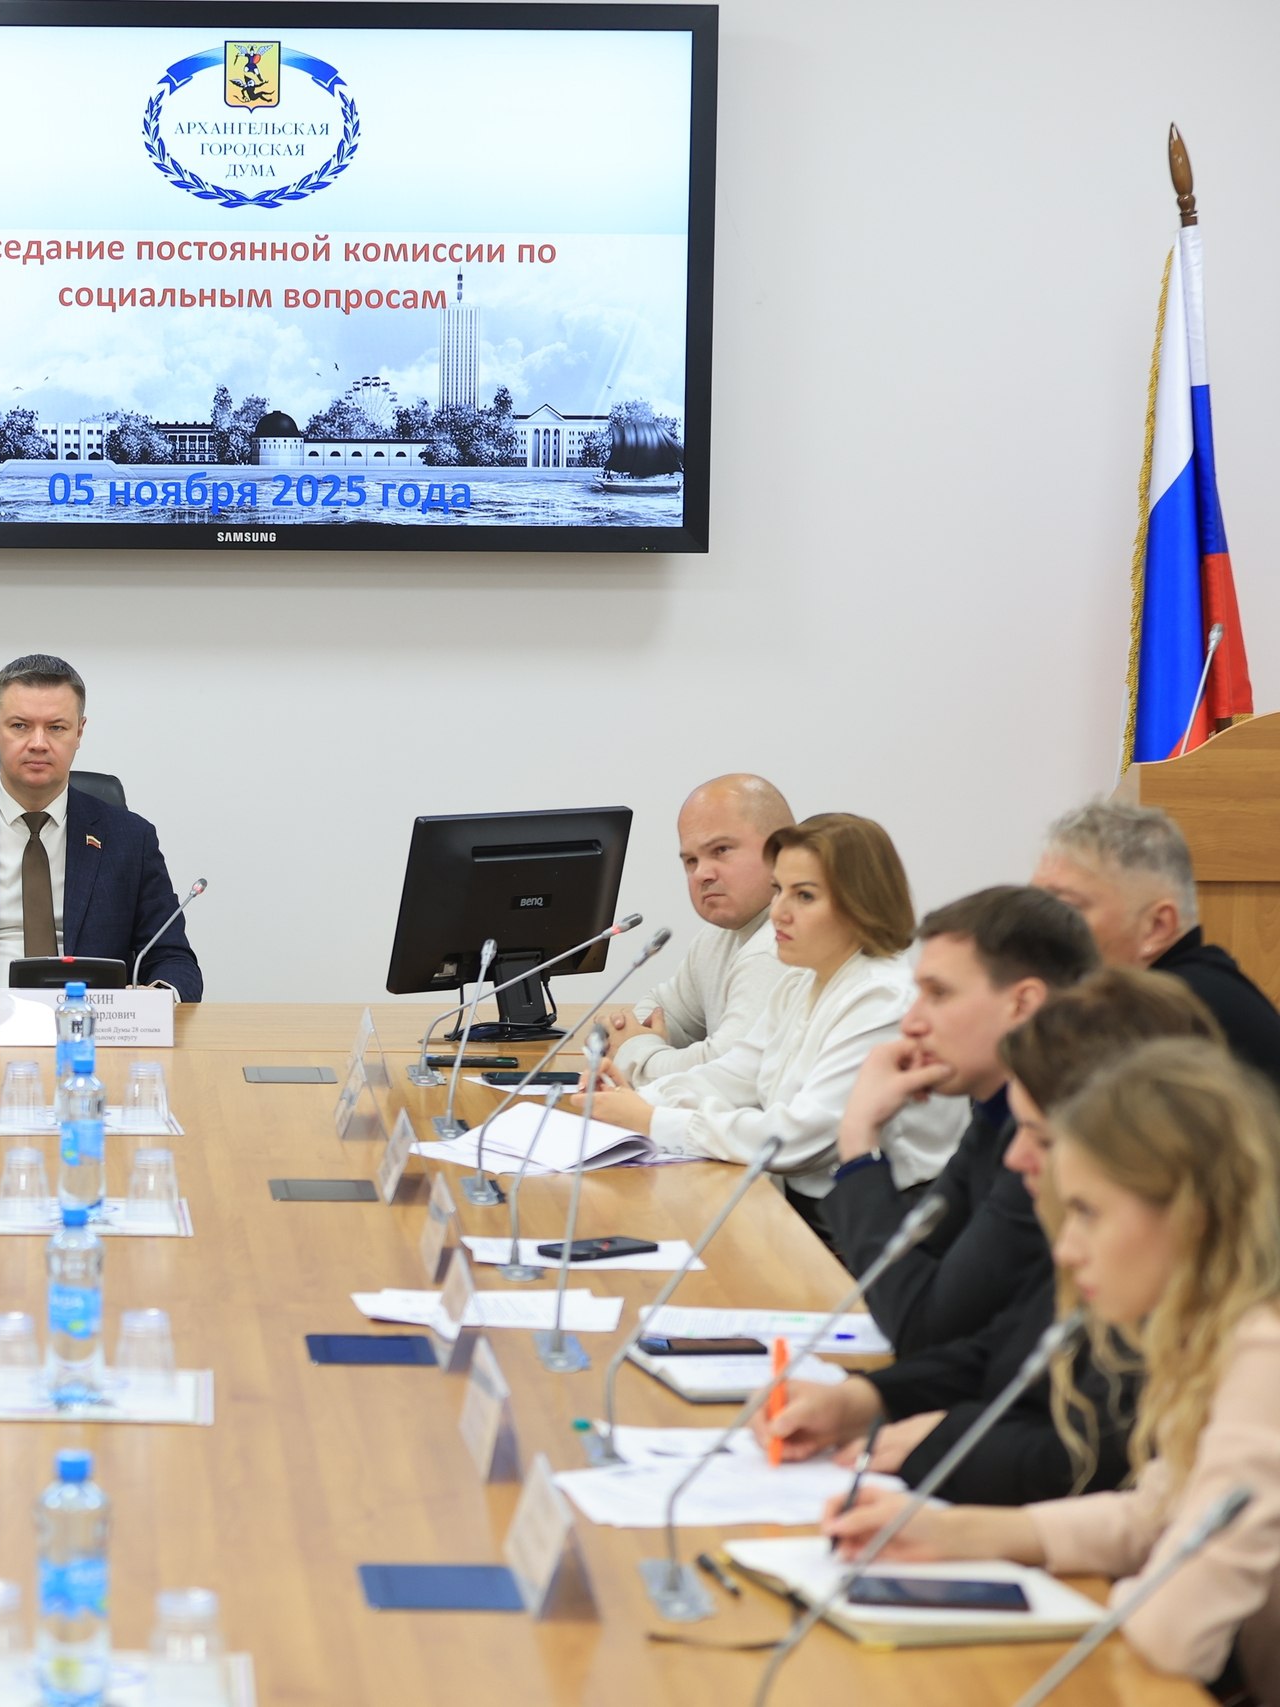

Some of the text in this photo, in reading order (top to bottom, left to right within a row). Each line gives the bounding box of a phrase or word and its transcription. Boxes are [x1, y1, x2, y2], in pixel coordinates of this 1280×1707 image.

[174, 121, 330, 136] АРХАНГЕЛЬСКАЯ
[200, 142, 305, 158] ГОРОДСКАЯ
[225, 163, 276, 179] ДУМА
[136, 234, 331, 262] постоянной
[344, 241, 505, 263] комиссии
[517, 243, 557, 264] по
[57, 286, 448, 316] социальным вопросам
[47, 471, 472, 515] 05 ноября 2025 года
[216, 531, 277, 543] SAMSUNG
